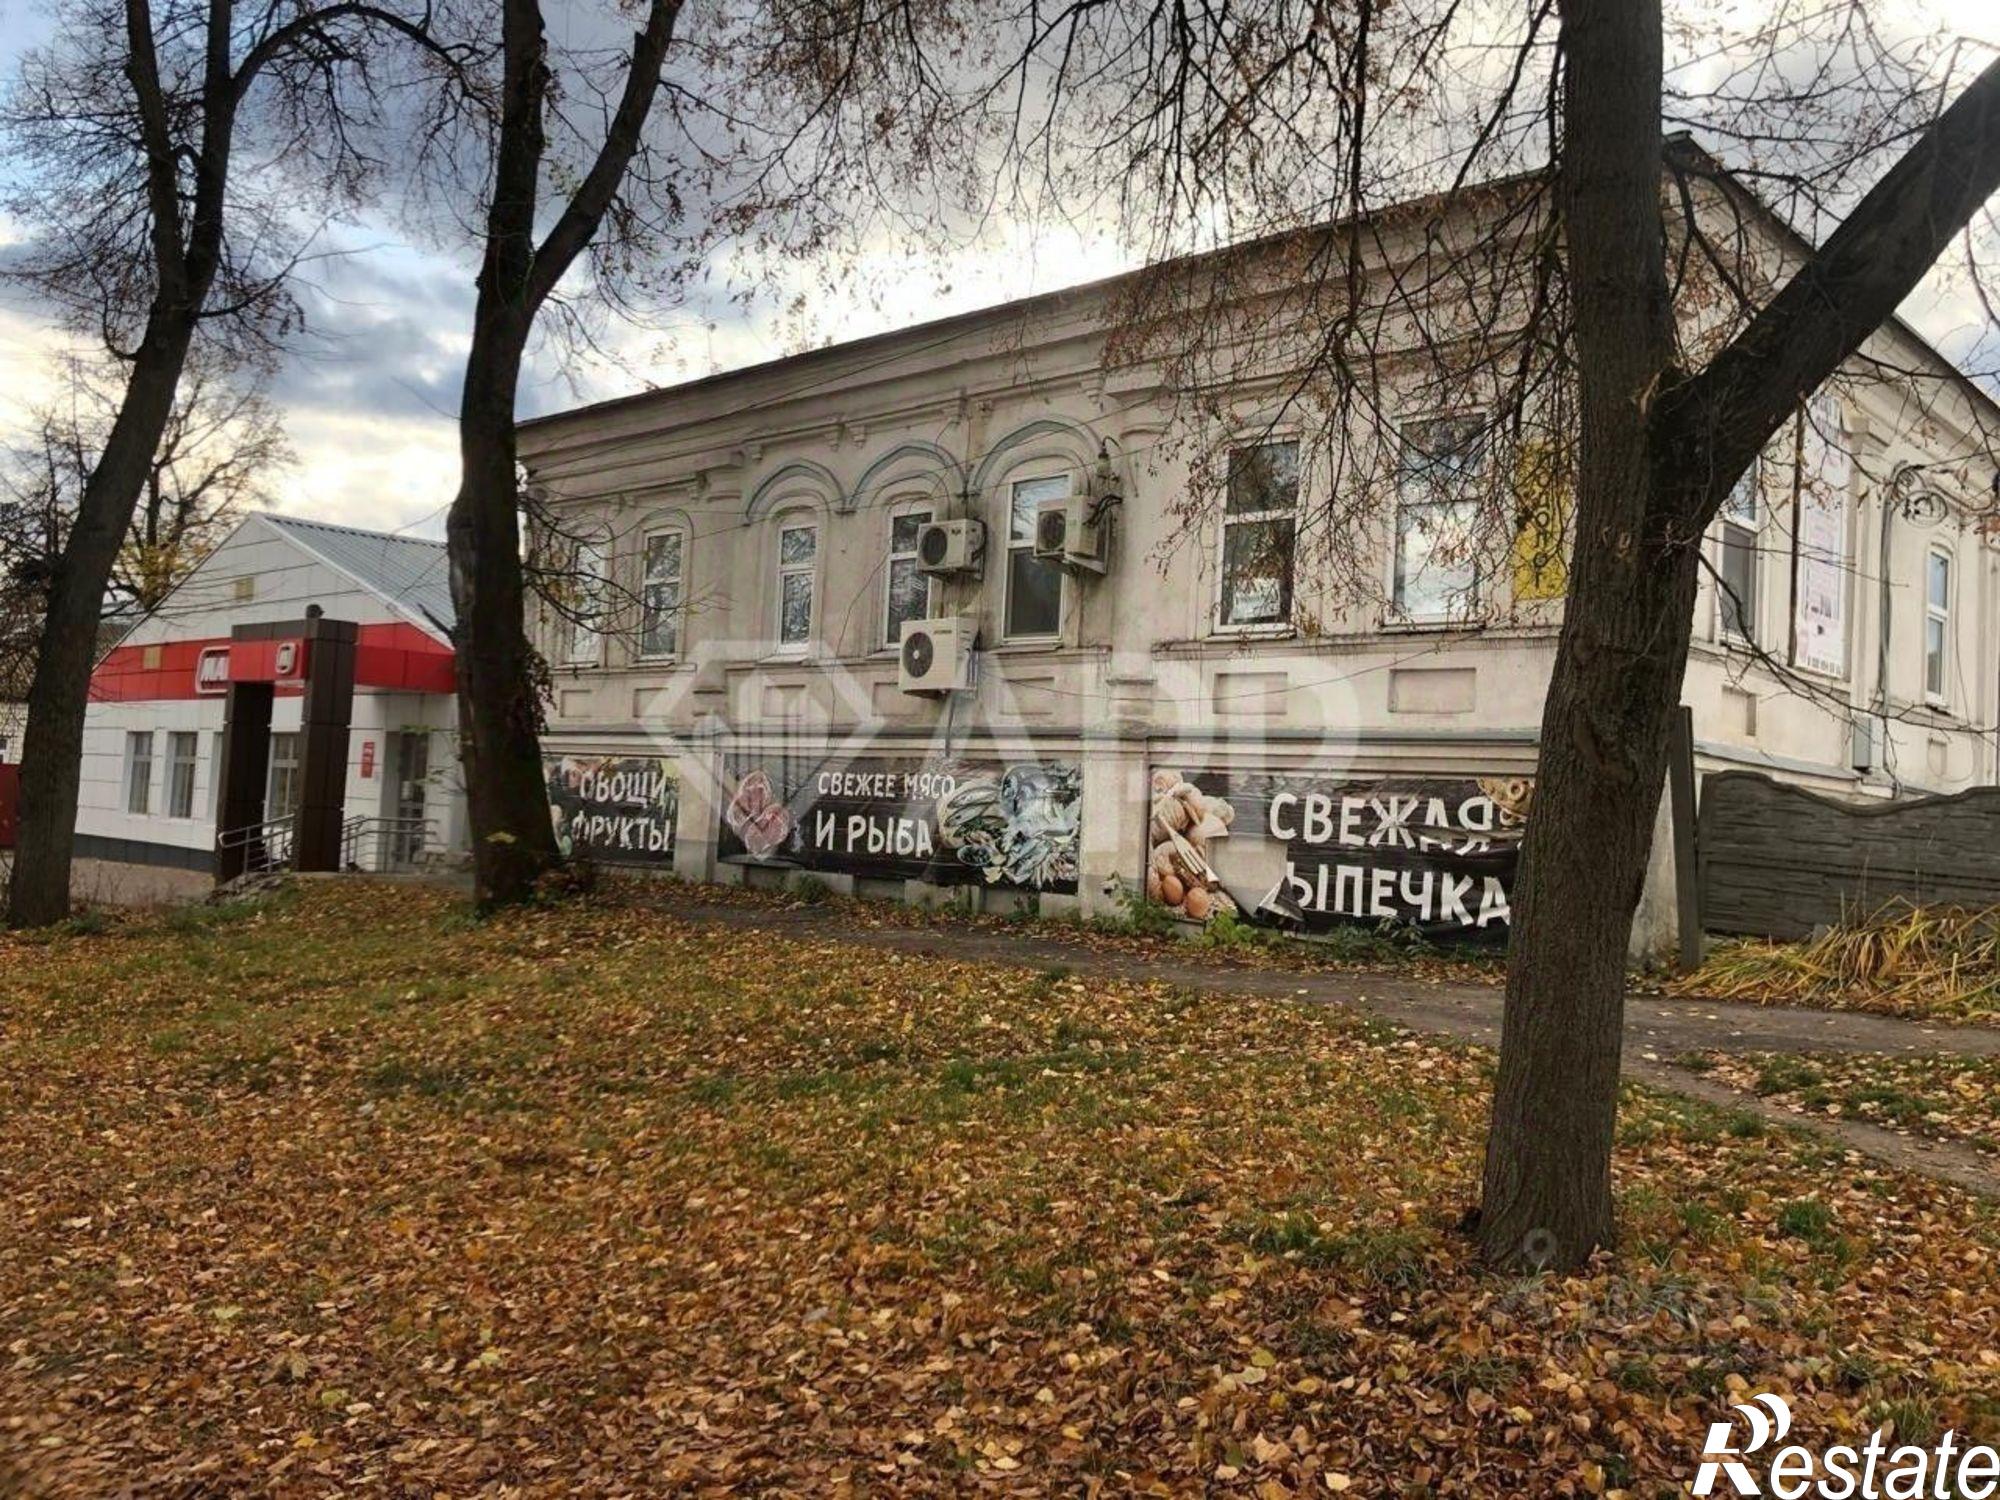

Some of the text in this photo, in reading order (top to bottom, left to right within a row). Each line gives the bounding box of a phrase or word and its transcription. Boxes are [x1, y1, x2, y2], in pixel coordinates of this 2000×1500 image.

[579, 769, 667, 814] ОВОЩИ
[818, 771, 956, 800] СВЕЖЕЕ МЯСО
[571, 810, 671, 852] ФРУКТЫ
[815, 809, 934, 858] И РЫБА
[1269, 793, 1495, 856] СВЕЖАЯ
[1286, 861, 1511, 928] ЫПЕЧКА
